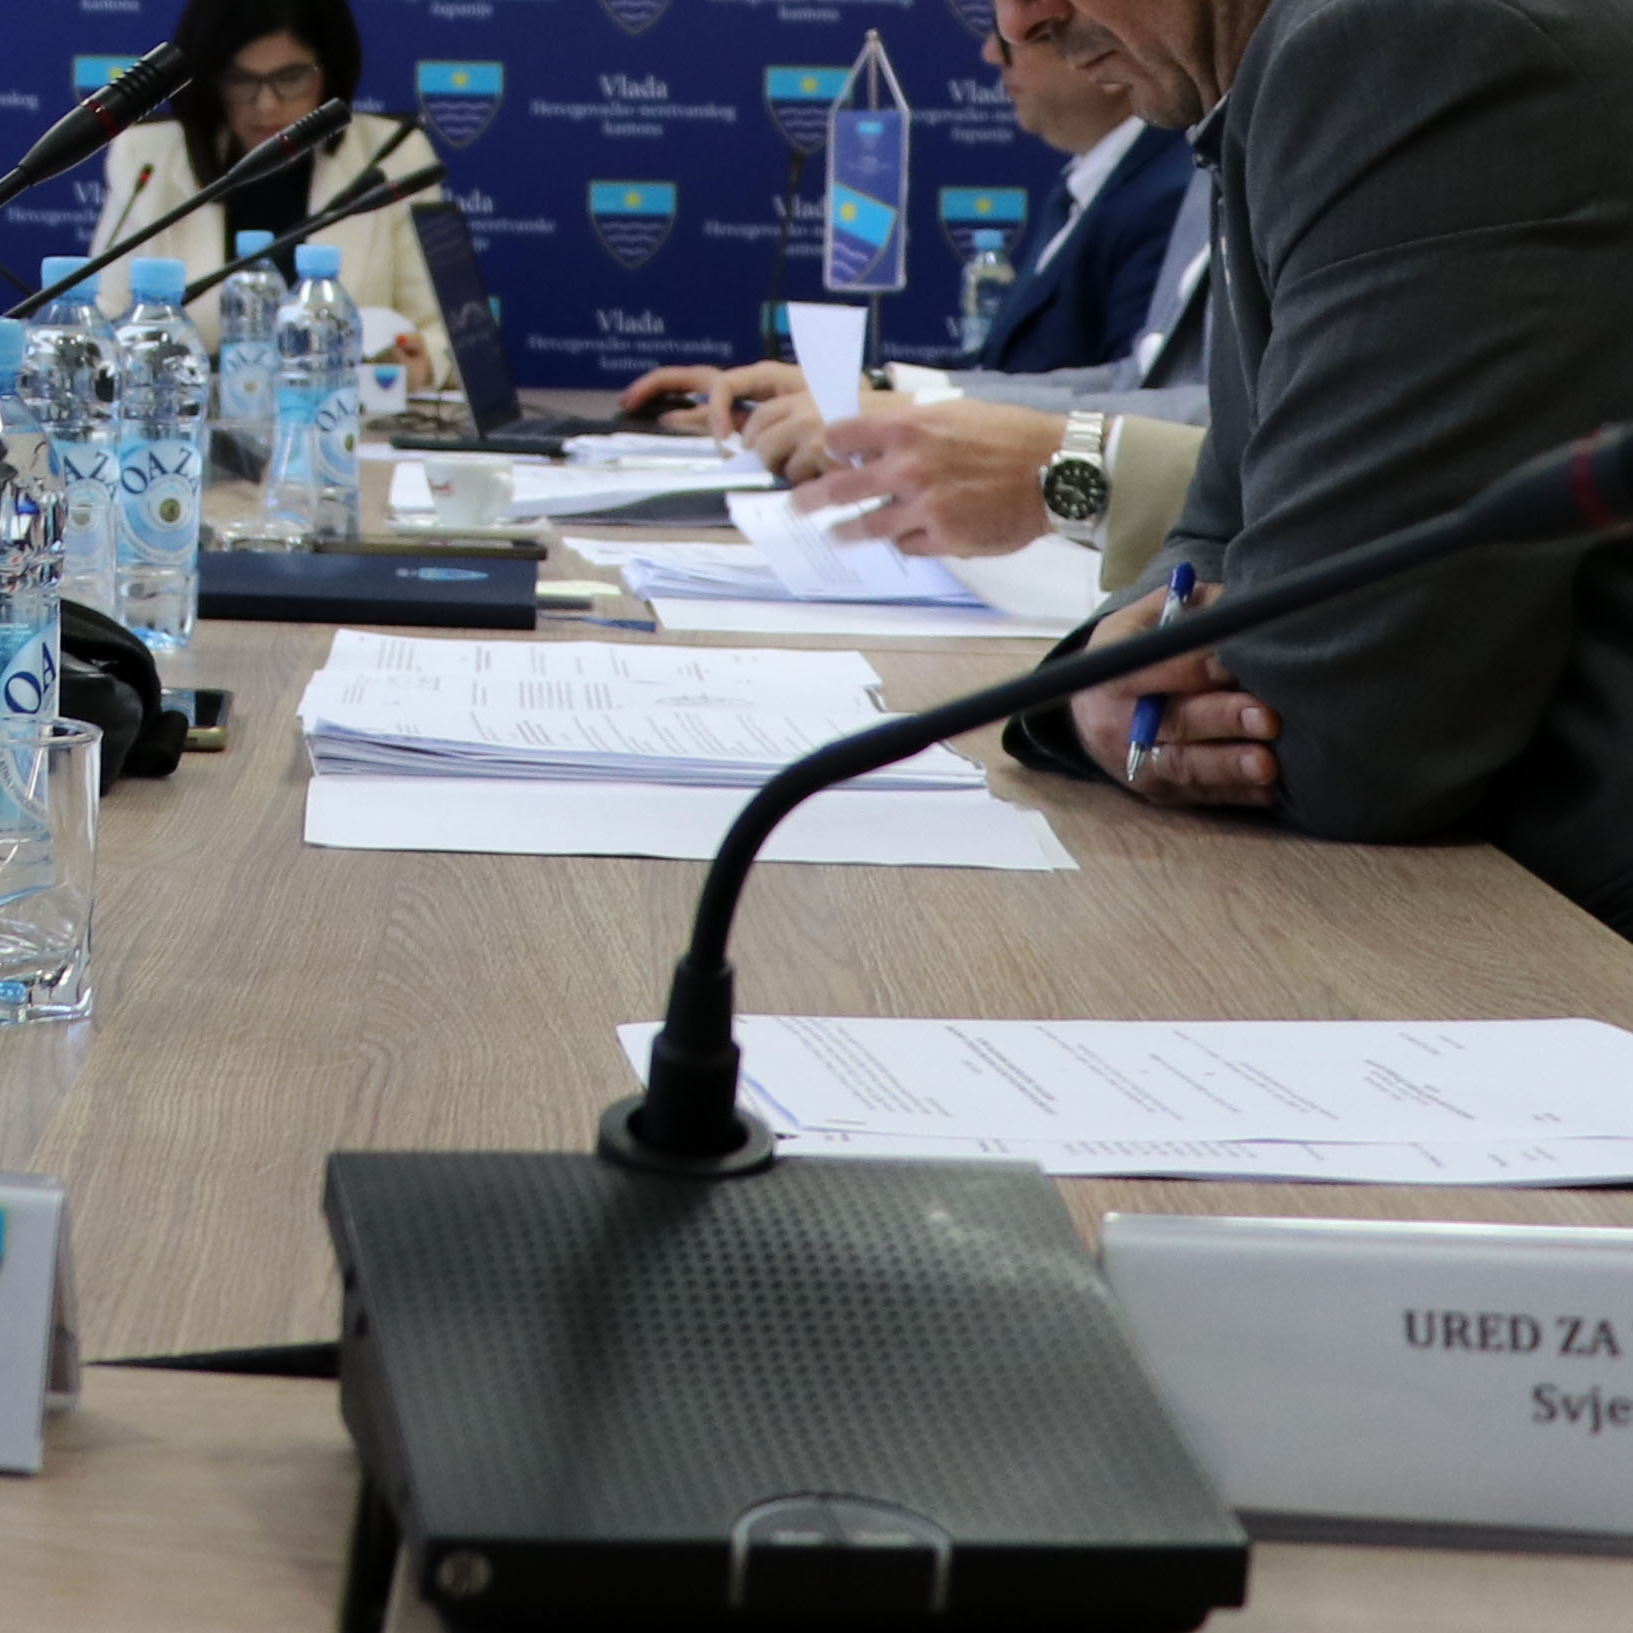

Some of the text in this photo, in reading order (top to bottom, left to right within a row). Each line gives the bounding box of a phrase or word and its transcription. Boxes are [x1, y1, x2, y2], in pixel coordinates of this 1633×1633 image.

[600, 74, 668, 99] Vlada
[597, 309, 665, 334] Vlada
[62, 450, 119, 501] AZA
[3, 641, 57, 715] OA
[1403, 1308, 1622, 1358] URED ZA
